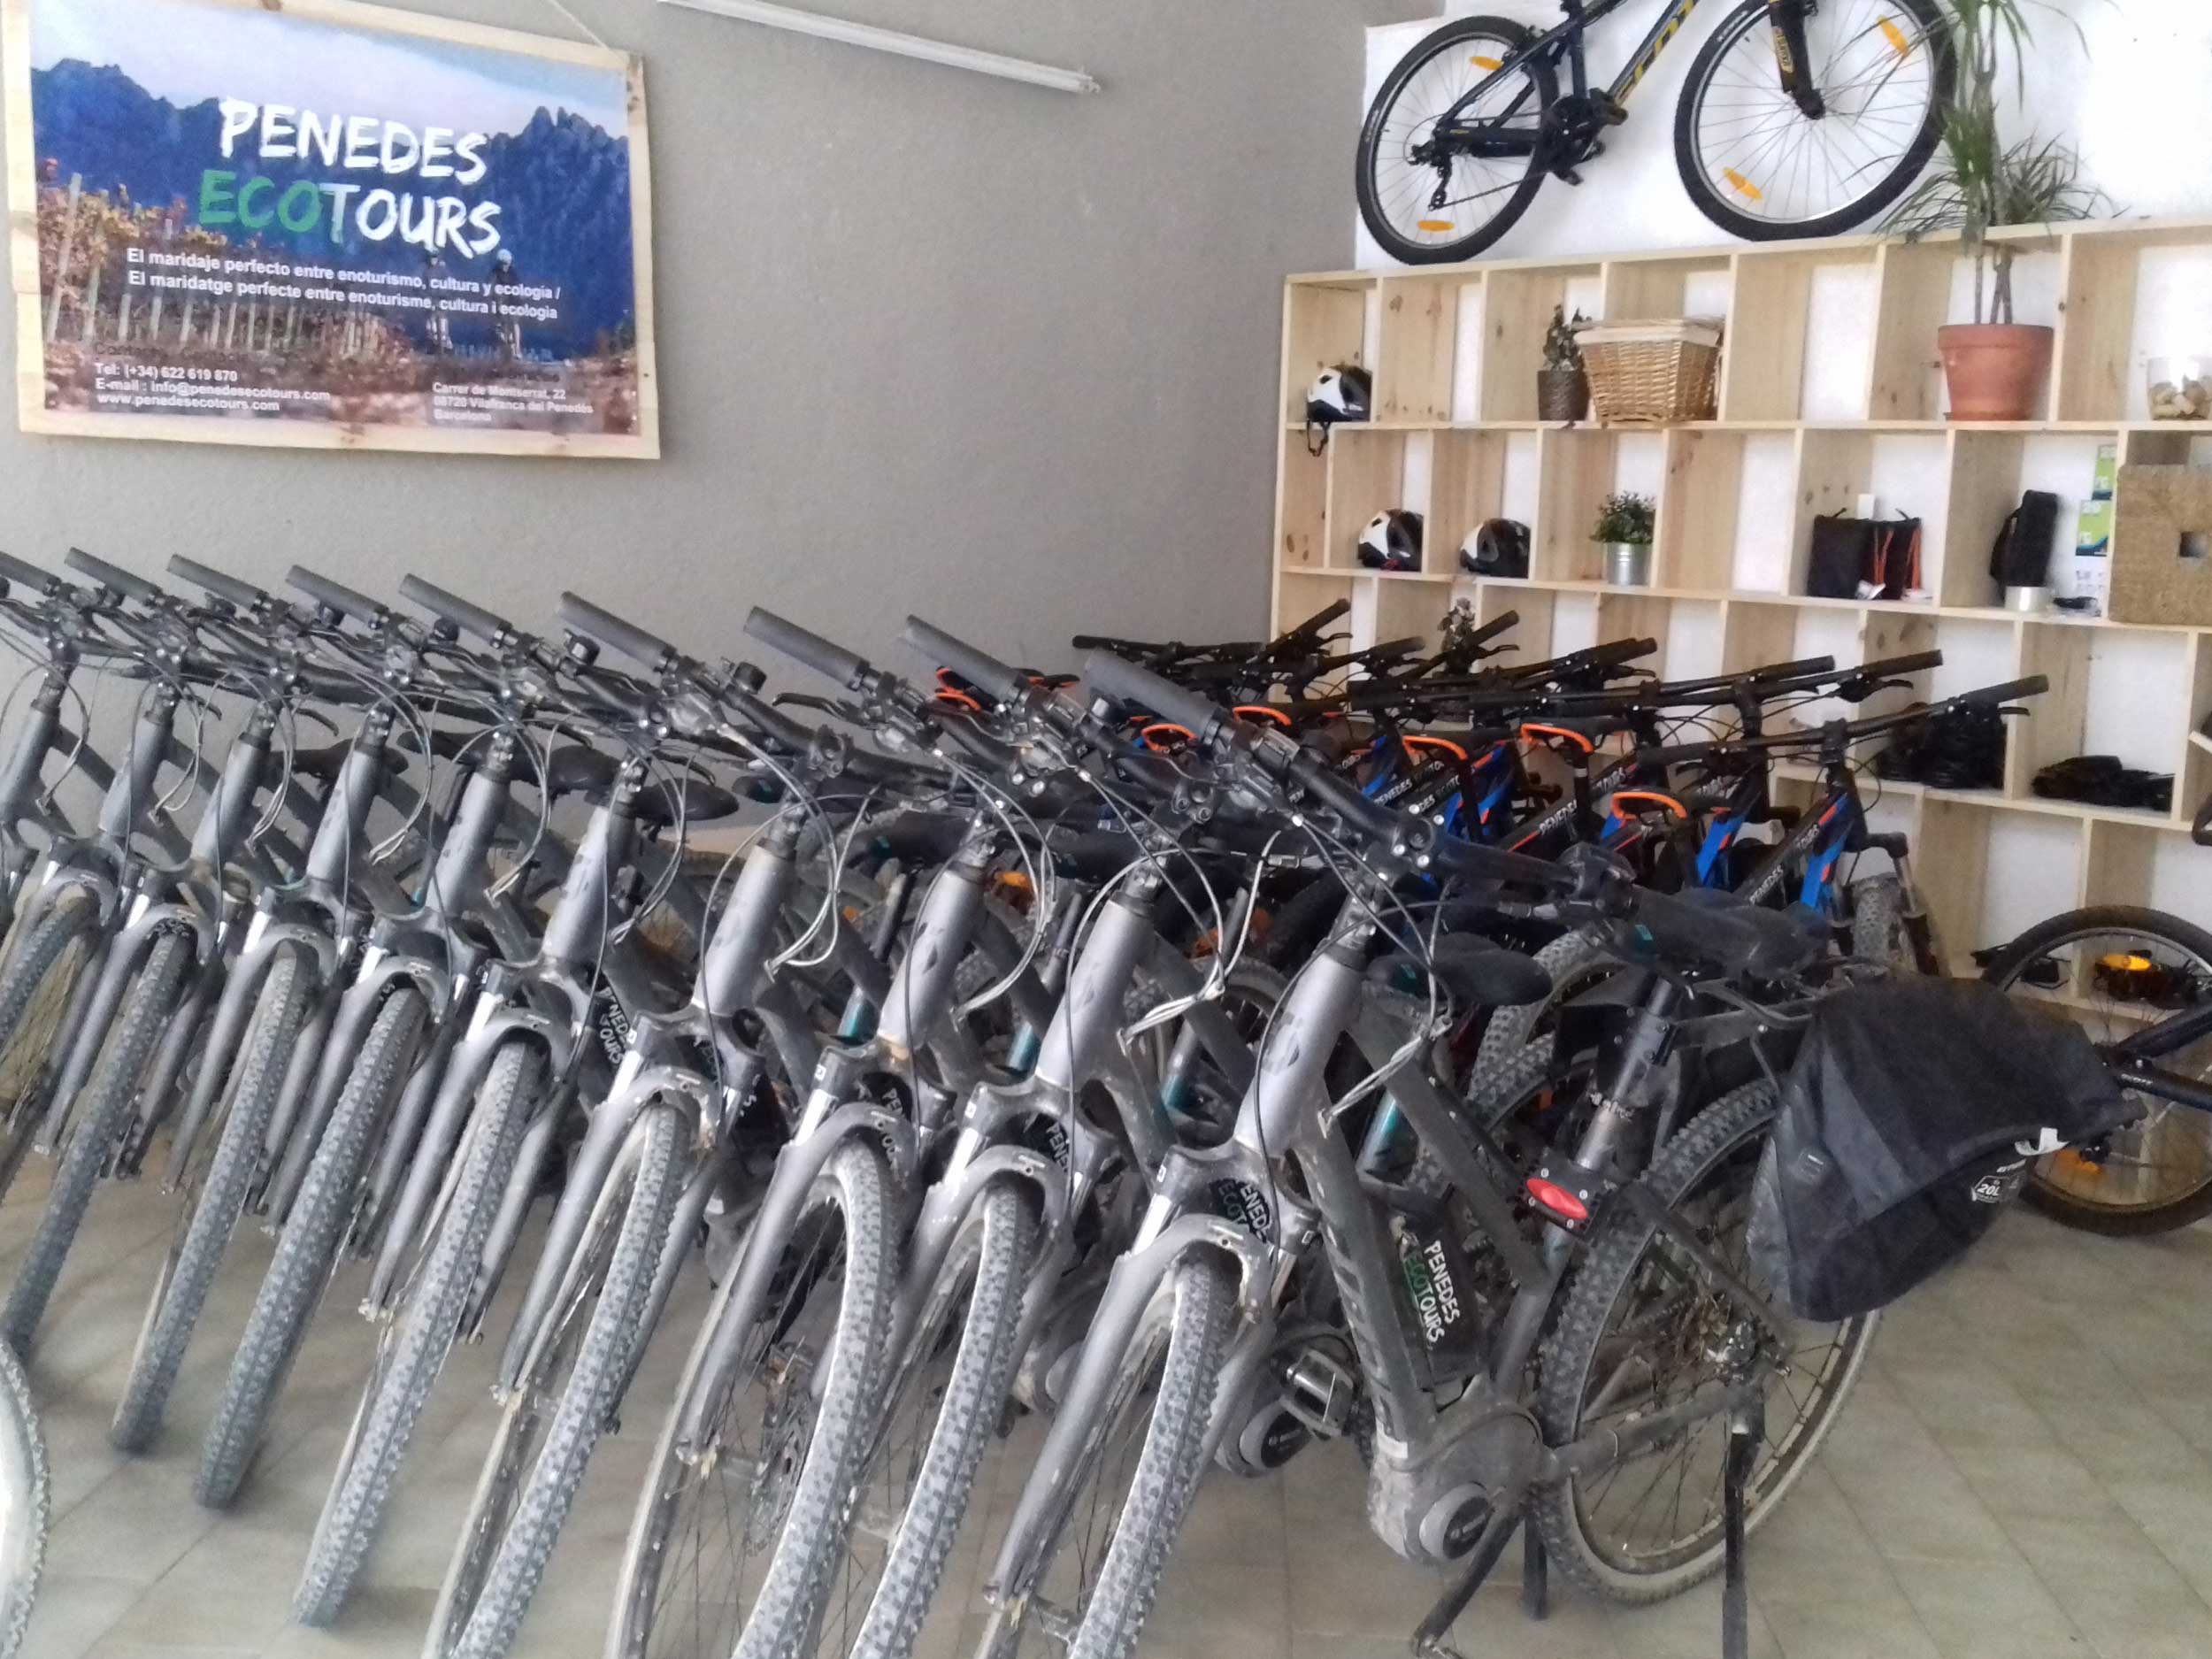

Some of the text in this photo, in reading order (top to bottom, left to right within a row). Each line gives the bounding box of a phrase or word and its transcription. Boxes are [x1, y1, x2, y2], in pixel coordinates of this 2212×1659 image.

[219, 96, 488, 186] PENEDES
[198, 169, 502, 259] ECOTOURS
[127, 248, 144, 263] El
[149, 252, 220, 273] maridaje
[225, 258, 290, 276] perfecto
[294, 264, 334, 280] entre
[337, 268, 426, 290] enoturismo,
[429, 274, 480, 292] cultura
[482, 283, 492, 296] y
[555, 287, 561, 300] /
[128, 270, 558, 321] El maridatge perfecte entre enoturisme, cultura i ecologia
[95, 362, 238, 382] Tel: (+34) 622 619 870
[95, 378, 139, 393] E-mail
[150, 381, 331, 401] info@penedesecotours.com
[471, 384, 486, 396] de
[553, 388, 566, 400] 22
[97, 394, 280, 412] www.penedesecotours.com
[1402, 1255, 1445, 1343] ECOTOURS
[1424, 1240, 1460, 1325] PENEDES
